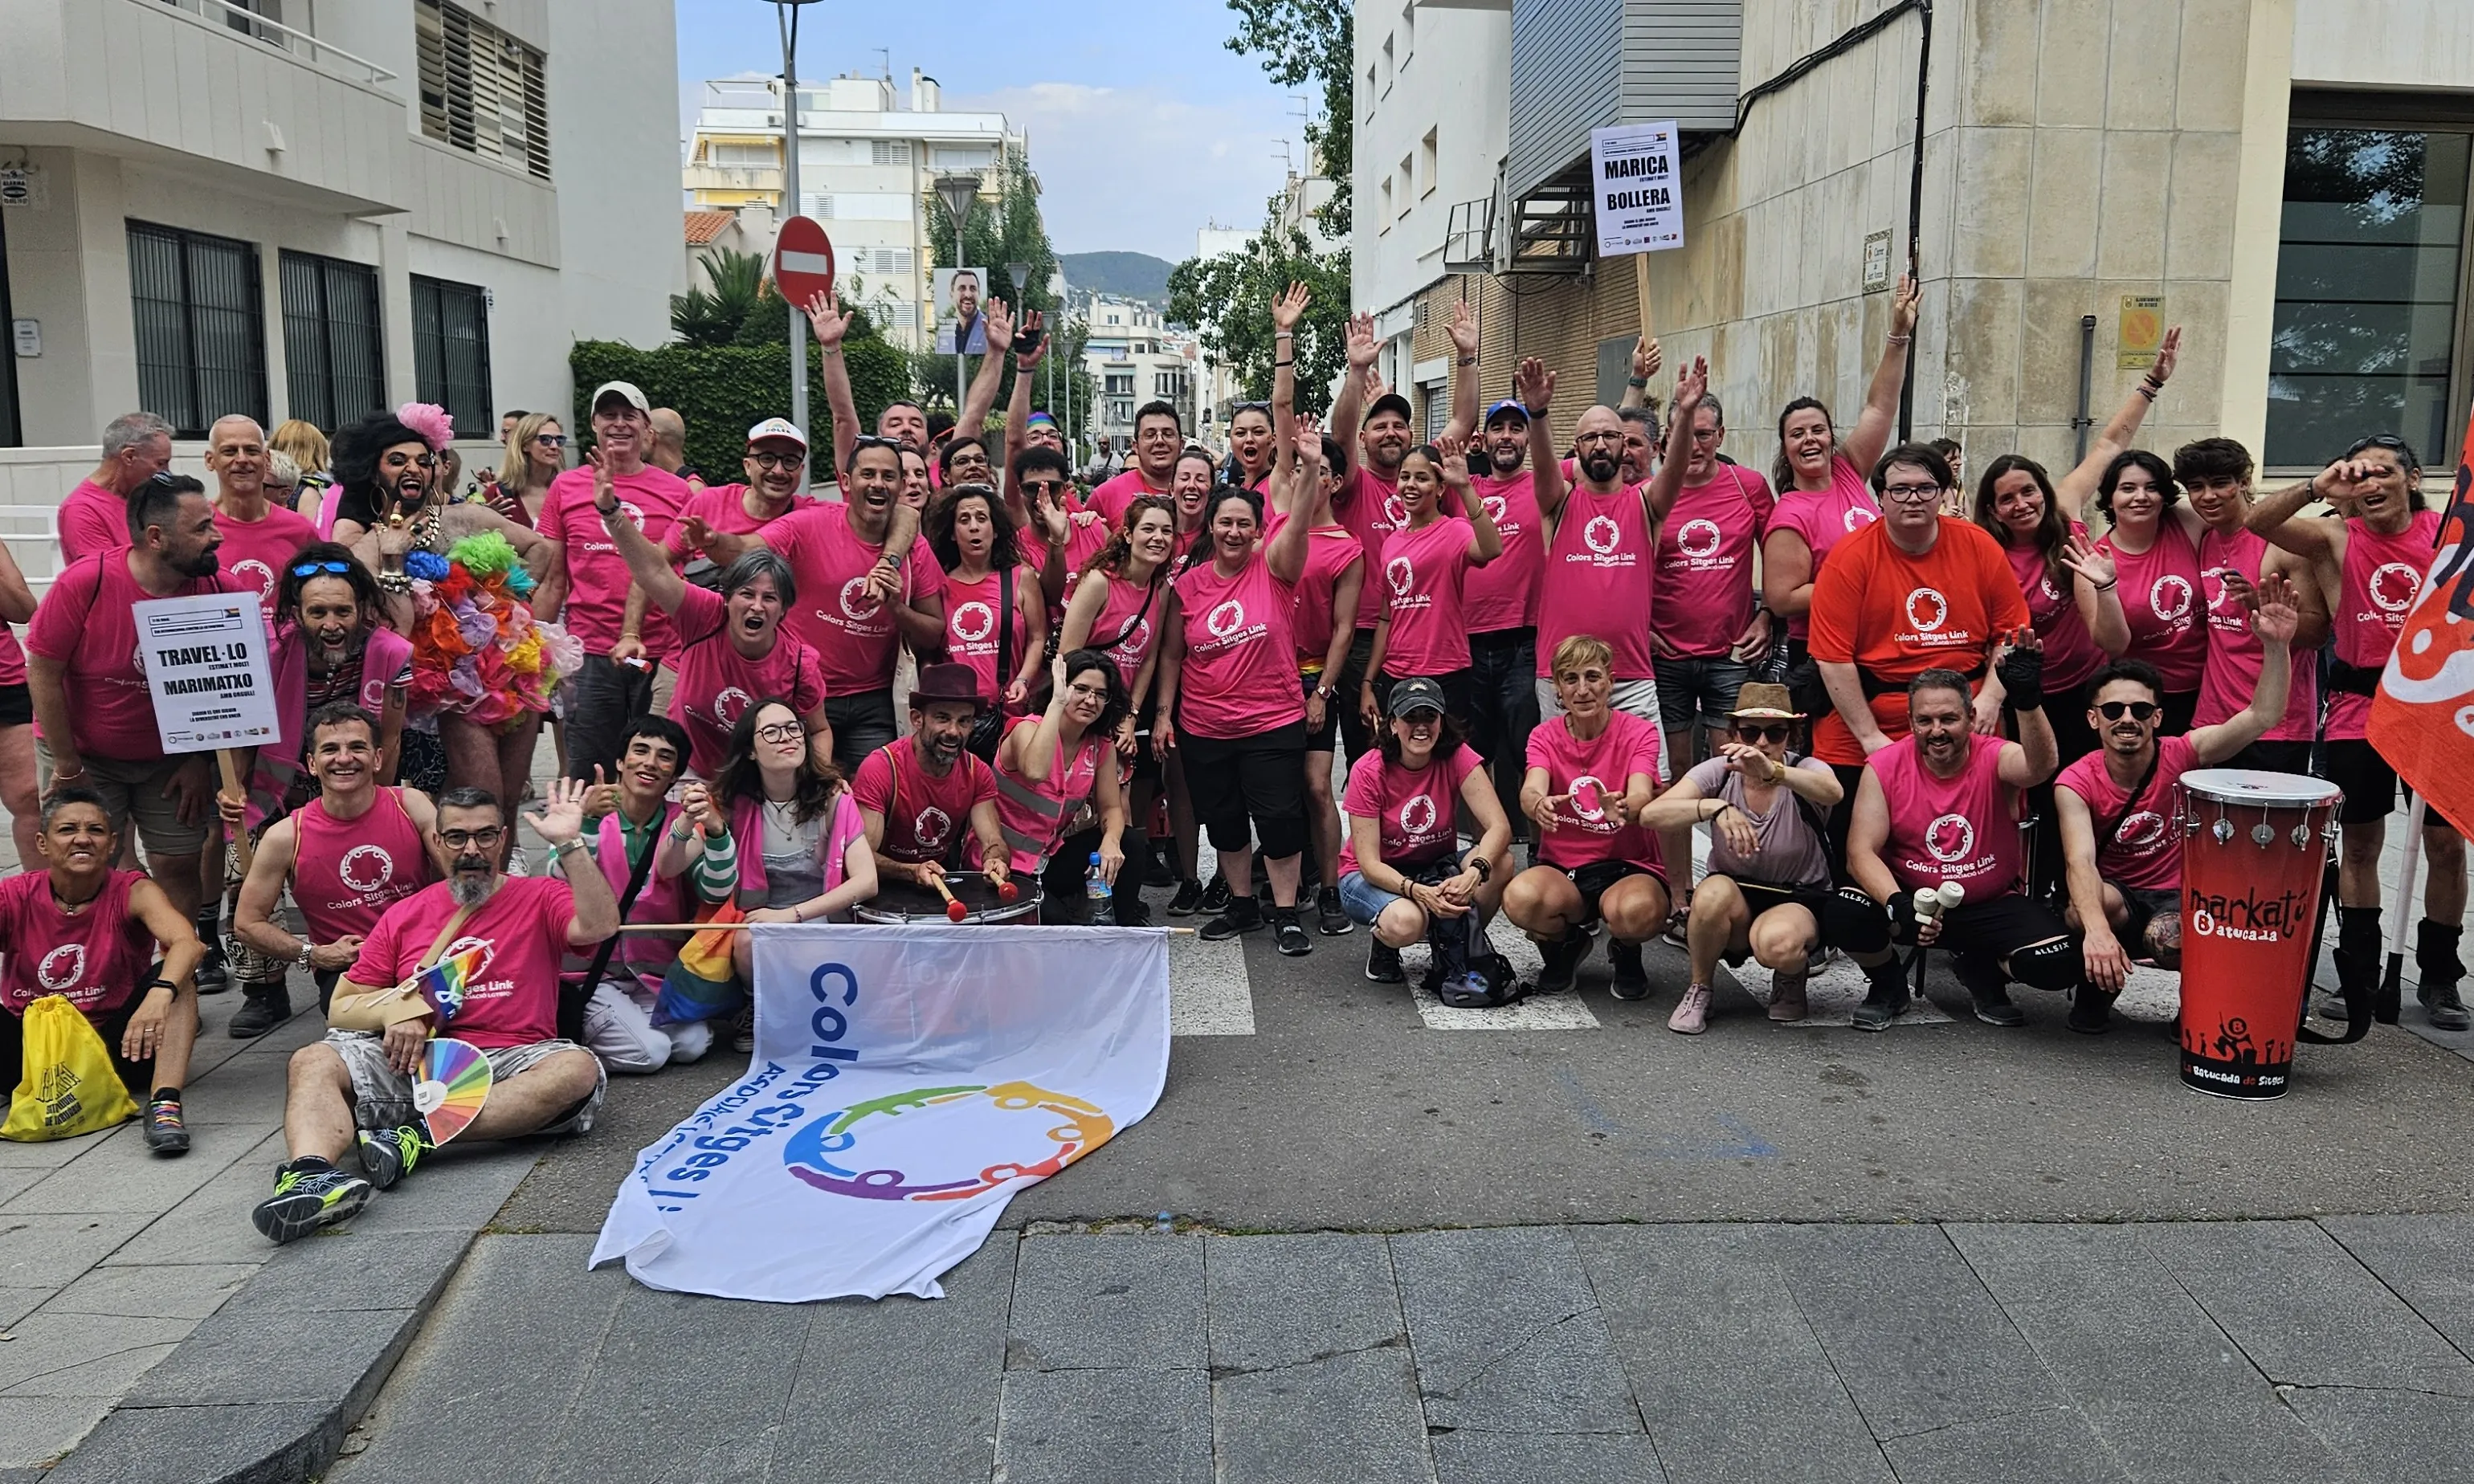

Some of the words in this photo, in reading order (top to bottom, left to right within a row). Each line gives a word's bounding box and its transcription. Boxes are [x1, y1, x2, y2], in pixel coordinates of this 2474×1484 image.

[1605, 155, 1668, 180] MARICA
[1607, 187, 1671, 210] BOLLERA
[584, 542, 613, 552] Colors
[1566, 552, 1592, 562] Colors
[1620, 552, 1636, 561] Link
[1664, 560, 1688, 569] Colors
[1690, 557, 1717, 567] Sitges
[1718, 556, 1735, 565] Link
[1415, 593, 1431, 602] Link
[816, 610, 844, 626] Colors
[845, 620, 872, 632] Sitges
[2223, 615, 2243, 626] Link
[1194, 642, 1221, 653] Colors
[1221, 630, 1248, 645] Sitges
[1248, 622, 1267, 634] Link
[1894, 633, 1918, 642] Colors
[1920, 632, 1948, 642] Sitges
[1949, 630, 1969, 639] Link
[966, 642, 993, 651] Sitges
[1101, 650, 1121, 660] olors
[163, 673, 253, 695] MARIMATXO
[1558, 814, 1580, 826] olors
[1409, 834, 1435, 844] Sitges
[1905, 859, 1939, 874] Colors
[1941, 862, 1975, 874] Sitges
[1977, 854, 1995, 868] Link
[327, 897, 362, 909] Colors
[1839, 891, 1872, 907] ALLSIX
[2035, 941, 2069, 956] ALLSIX
[465, 984, 487, 995] ges
[488, 980, 514, 992] Link
[2193, 1066, 2240, 1084] Batucada
[2243, 1076, 2256, 1085] de
[2258, 1075, 2284, 1086] Sitges
